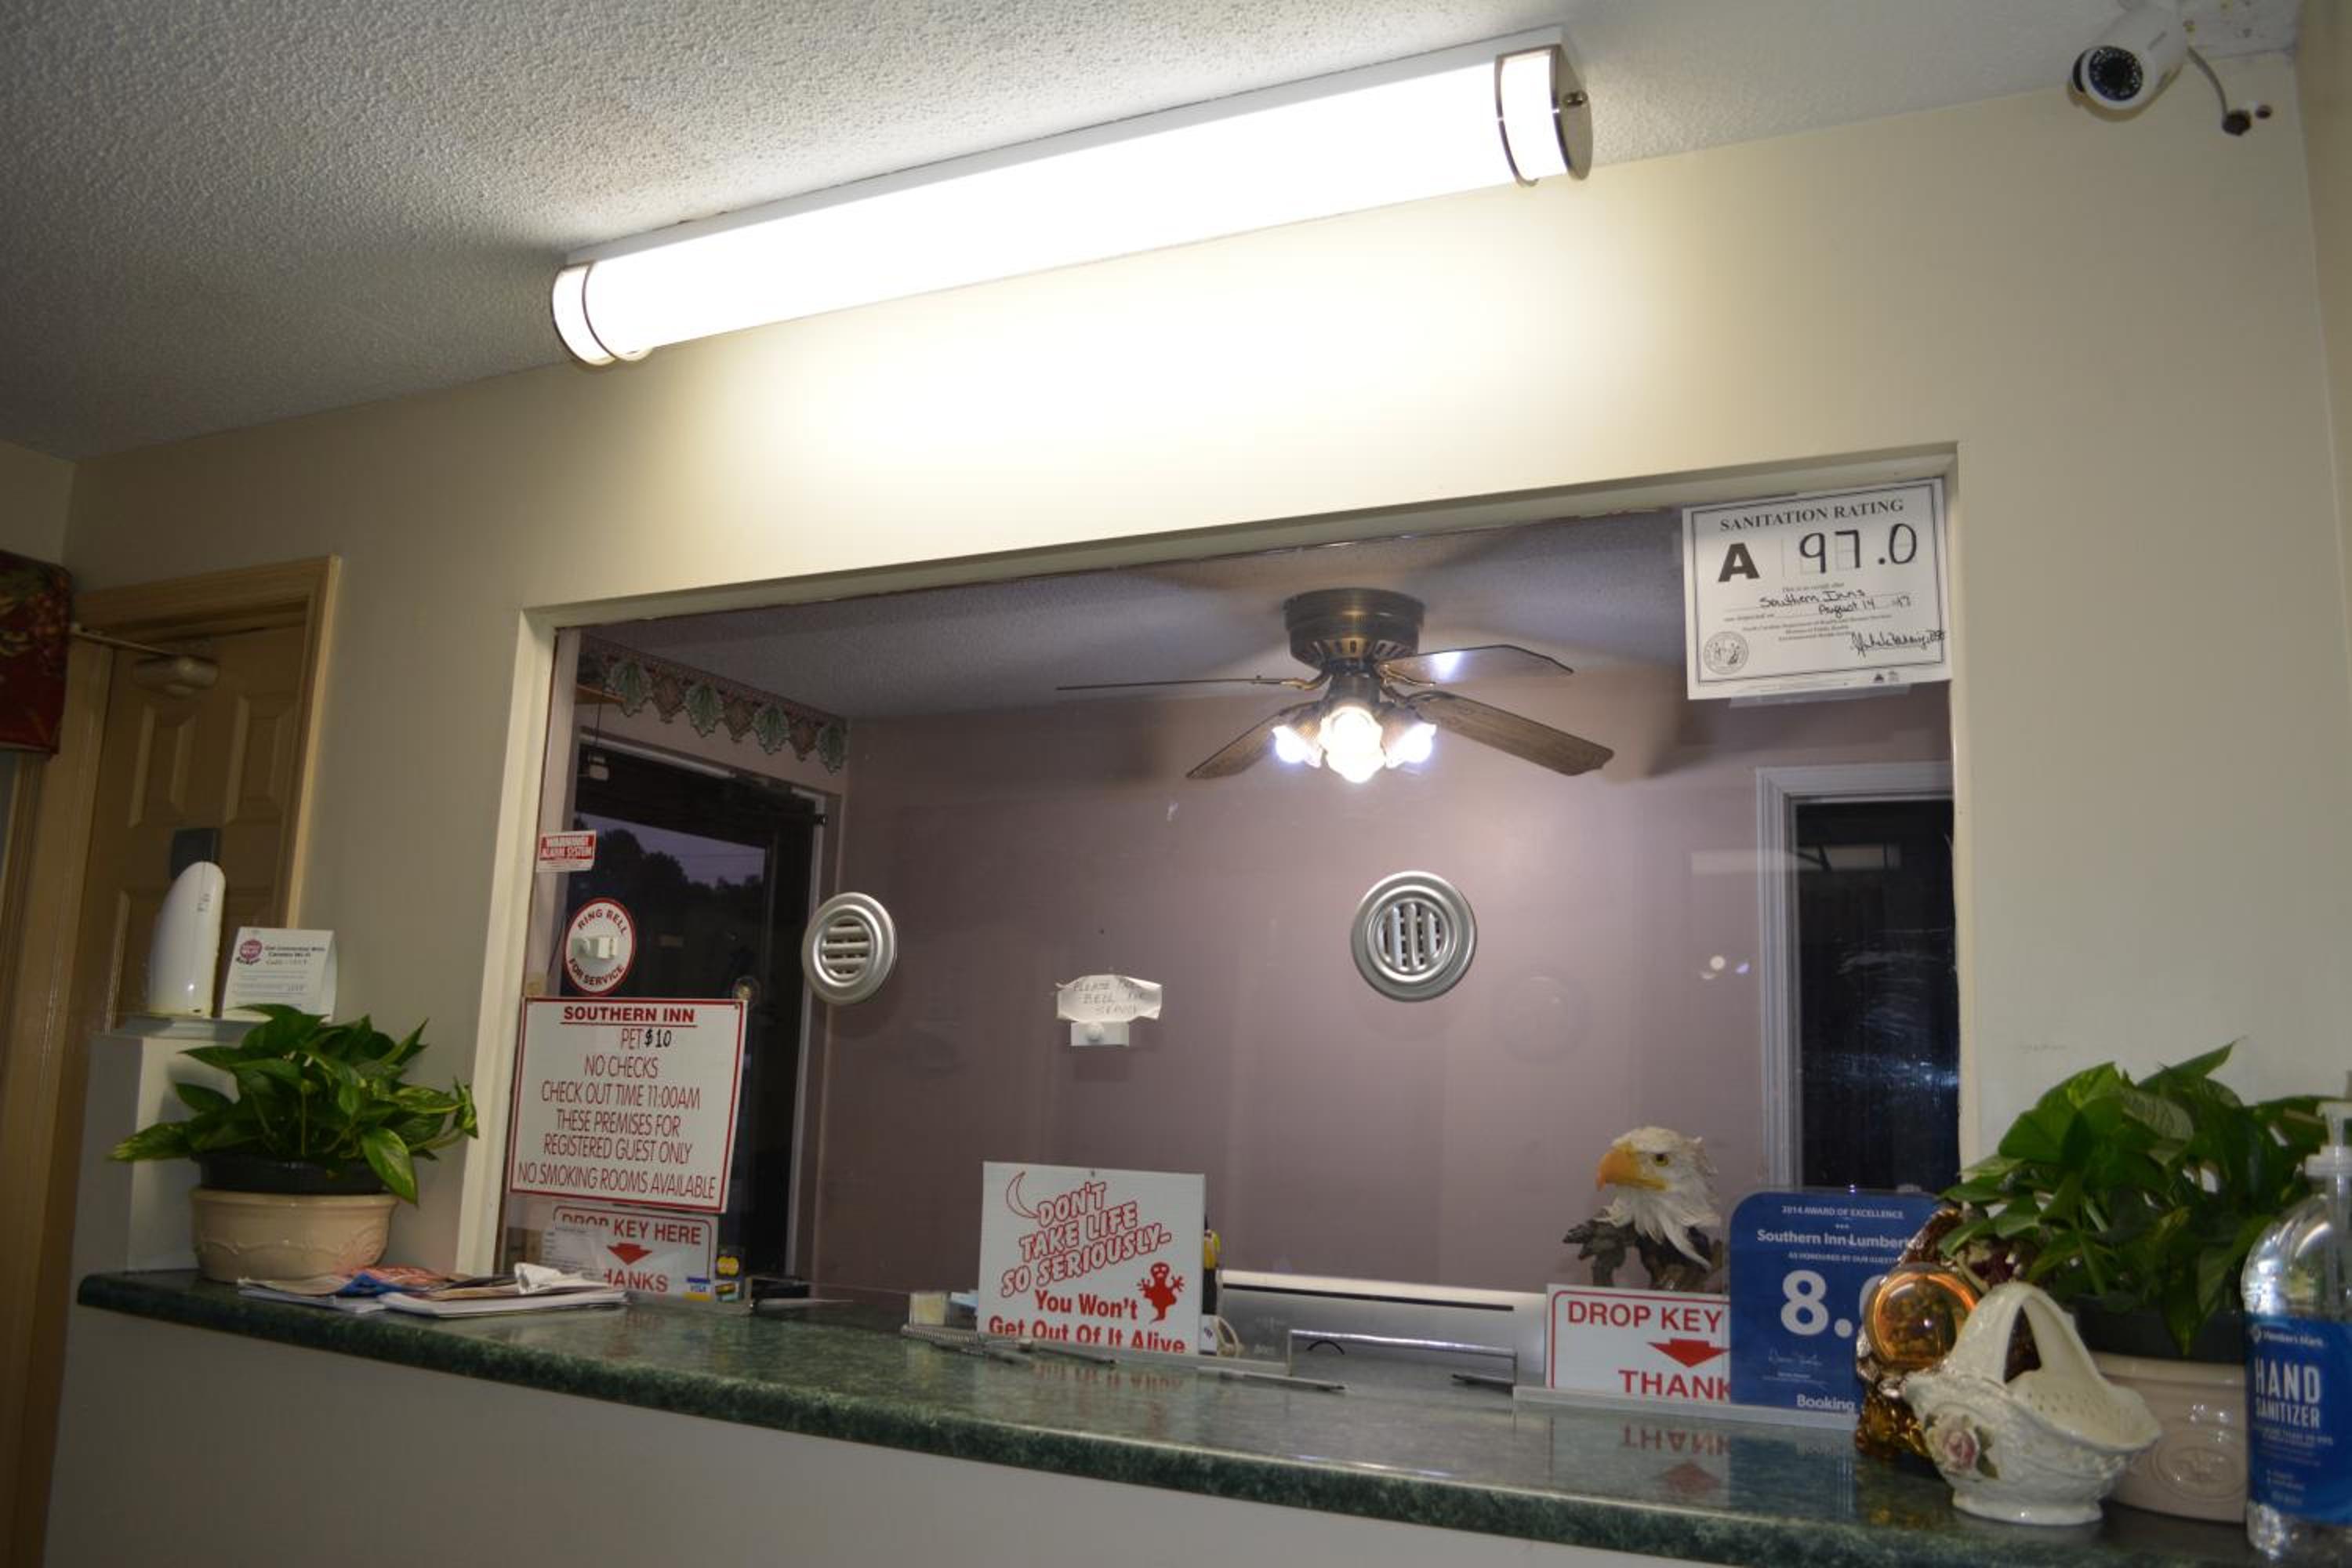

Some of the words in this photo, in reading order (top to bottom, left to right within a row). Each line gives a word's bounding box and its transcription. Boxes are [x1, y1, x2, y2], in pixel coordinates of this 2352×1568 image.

[1719, 503, 1829, 532] SANITATION
[1834, 499, 1904, 519] RATING
[1718, 542, 1760, 582] A
[1798, 523, 1917, 573] 97.0
[1759, 594, 1819, 608] Southern
[578, 909, 603, 931] RING
[606, 909, 626, 935] BELL
[569, 957, 585, 978] FOR
[583, 965, 625, 985] SERVICE
[564, 1007, 657, 1022] SOUTHERN
[663, 1009, 695, 1023] INN
[621, 1028, 644, 1050] PET
[644, 1029, 672, 1047] $10
[584, 1054, 606, 1076] NO
[608, 1057, 659, 1079] CHECKS
[542, 1080, 583, 1102] CHECK
[587, 1083, 613, 1104] OUT
[615, 1085, 644, 1106] TIME
[648, 1086, 700, 1110] 11:00AM
[557, 1109, 590, 1131] THESE
[593, 1112, 652, 1136] PREMISES
[655, 1115, 681, 1138] FOR
[543, 1134, 612, 1159] REGISTERED
[615, 1138, 656, 1161] GUEST
[659, 1141, 693, 1164] ONLY
[518, 1163, 537, 1183] NO
[539, 1163, 598, 1189] SMOKING
[600, 1168, 648, 1193] ROOMS
[650, 1173, 717, 1200] AVAILABLE
[1037, 1181, 1106, 1228] DON'T
[1805, 1207, 1835, 1216] AWARD
[1837, 1208, 1848, 1217] OF
[1850, 1209, 1904, 1219] EXCELLENCE
[614, 1218, 649, 1239] KEY
[654, 1224, 702, 1245] HERE
[1020, 1219, 1079, 1262] TAKE
[1087, 1200, 1138, 1240] LIFE
[1757, 1229, 1821, 1245] Southern
[604, 1268, 669, 1292] HANKS
[1001, 1265, 1031, 1298] SO
[1035, 1290, 1072, 1312] You
[1079, 1294, 1138, 1319] Won't
[1568, 1301, 1650, 1327] DROP
[1661, 1306, 1722, 1333] KEY
[989, 1316, 1025, 1336] Get
[1032, 1320, 1069, 1340] Out
[1076, 1324, 1100, 1344] Of
[1108, 1328, 1122, 1346] It
[1131, 1330, 1186, 1353] Alive
[1618, 1370, 1730, 1401] THANK
[2256, 1356, 2321, 1404] HAND
[2256, 1396, 2321, 1429] SANITIZER
